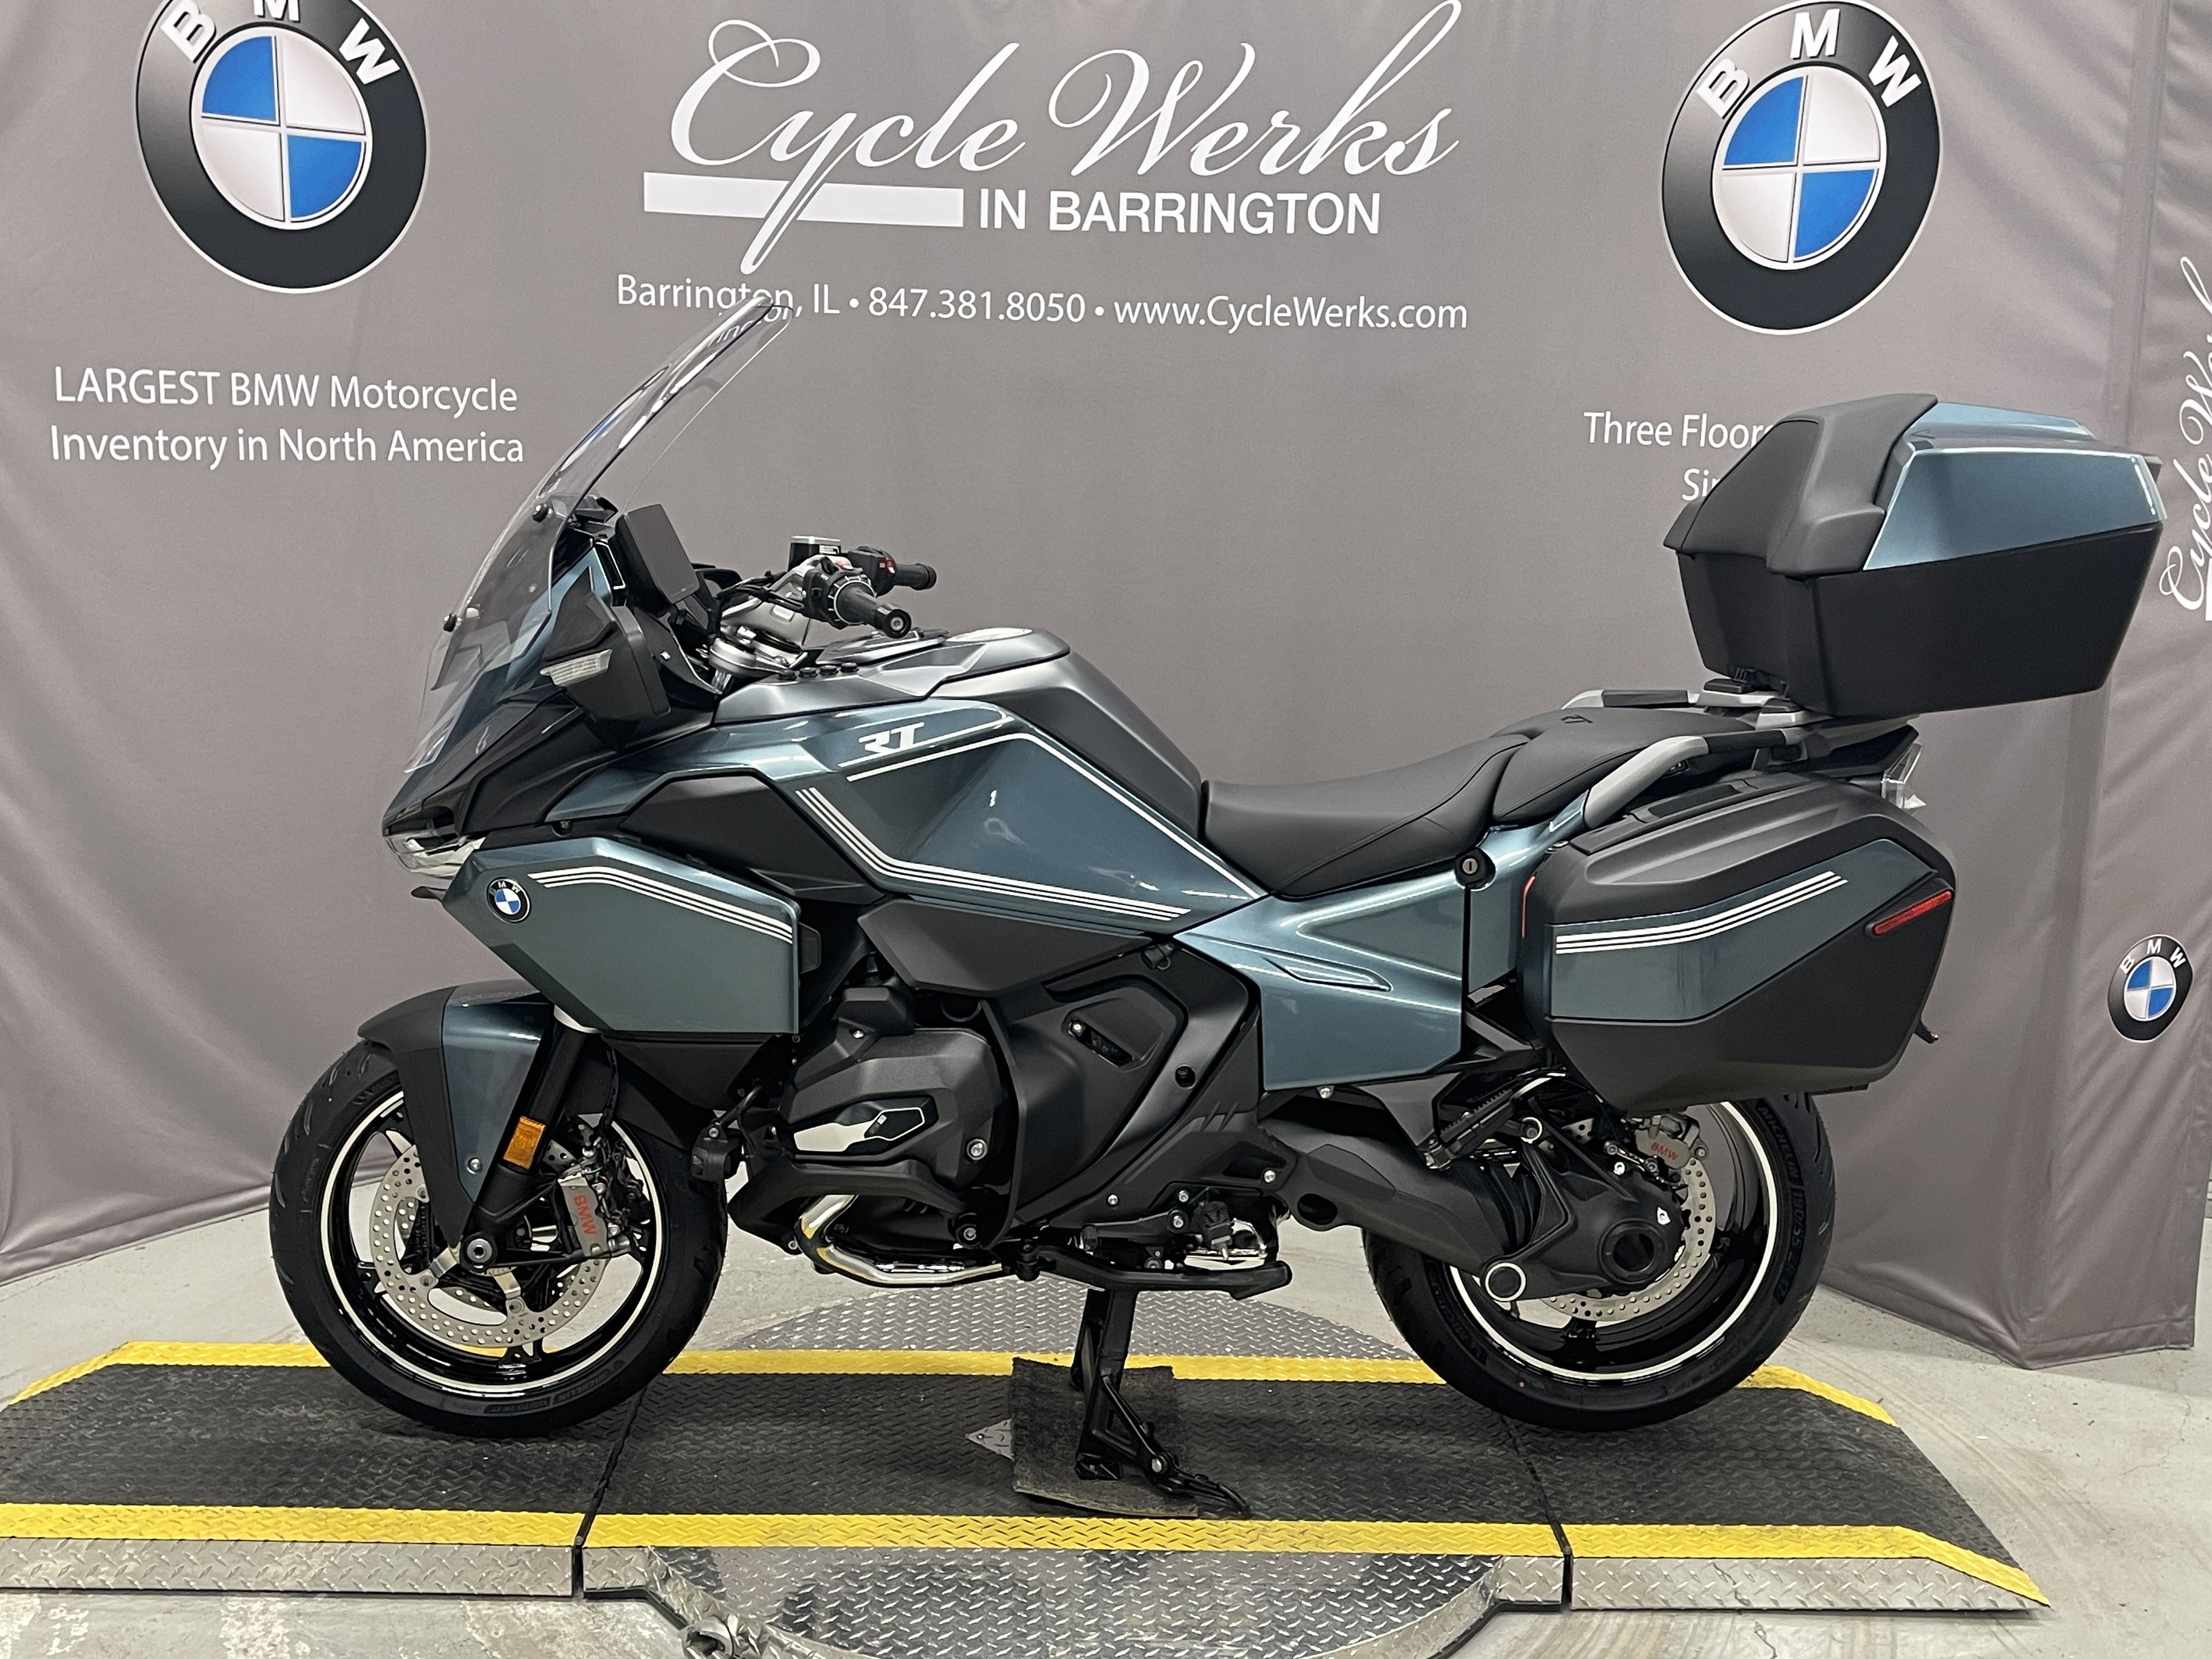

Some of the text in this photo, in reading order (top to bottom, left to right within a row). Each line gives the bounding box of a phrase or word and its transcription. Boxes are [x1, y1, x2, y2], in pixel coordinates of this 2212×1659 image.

[1696, 8, 1922, 119] BMW
[670, 0, 1463, 274] Cycle Werks
[980, 188, 1381, 235] IN BARRINGTON
[814, 283, 841, 314] IL
[868, 286, 1086, 323] 847.381.8050
[1113, 294, 1468, 335] www.CycleWerks.com
[55, 365, 518, 419] LARGEST BMW Motorcycle
[50, 424, 524, 471] Inventory in North America
[1583, 410, 1673, 447] Three
[859, 721, 925, 753] RT
[2119, 938, 2186, 974] BMW
[1650, 1142, 1679, 1161] BMW
[573, 1194, 597, 1234] BMW
